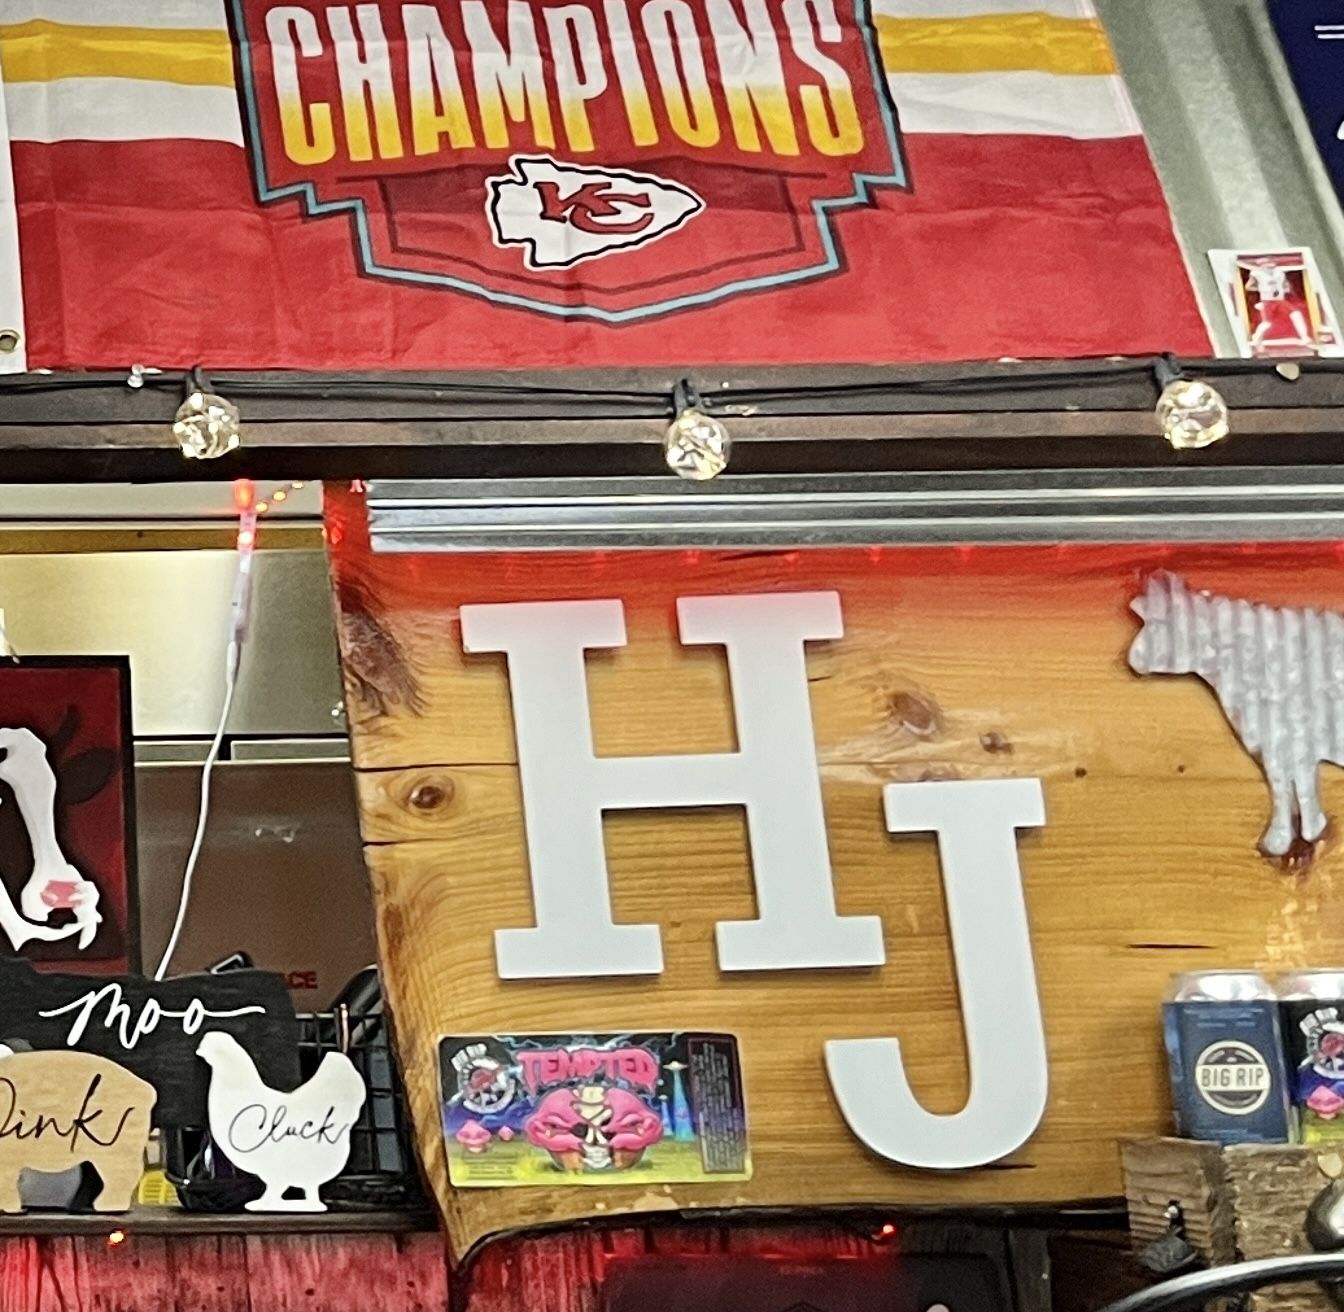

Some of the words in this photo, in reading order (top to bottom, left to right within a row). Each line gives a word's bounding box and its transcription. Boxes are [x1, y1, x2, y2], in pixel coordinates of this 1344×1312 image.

[533, 181, 655, 235] KC
[516, 1047, 660, 1095] TEMPTED
[1201, 1068, 1231, 1088] BIG
[1236, 1067, 1265, 1087] RIP
[228, 1103, 352, 1153] Cluck
